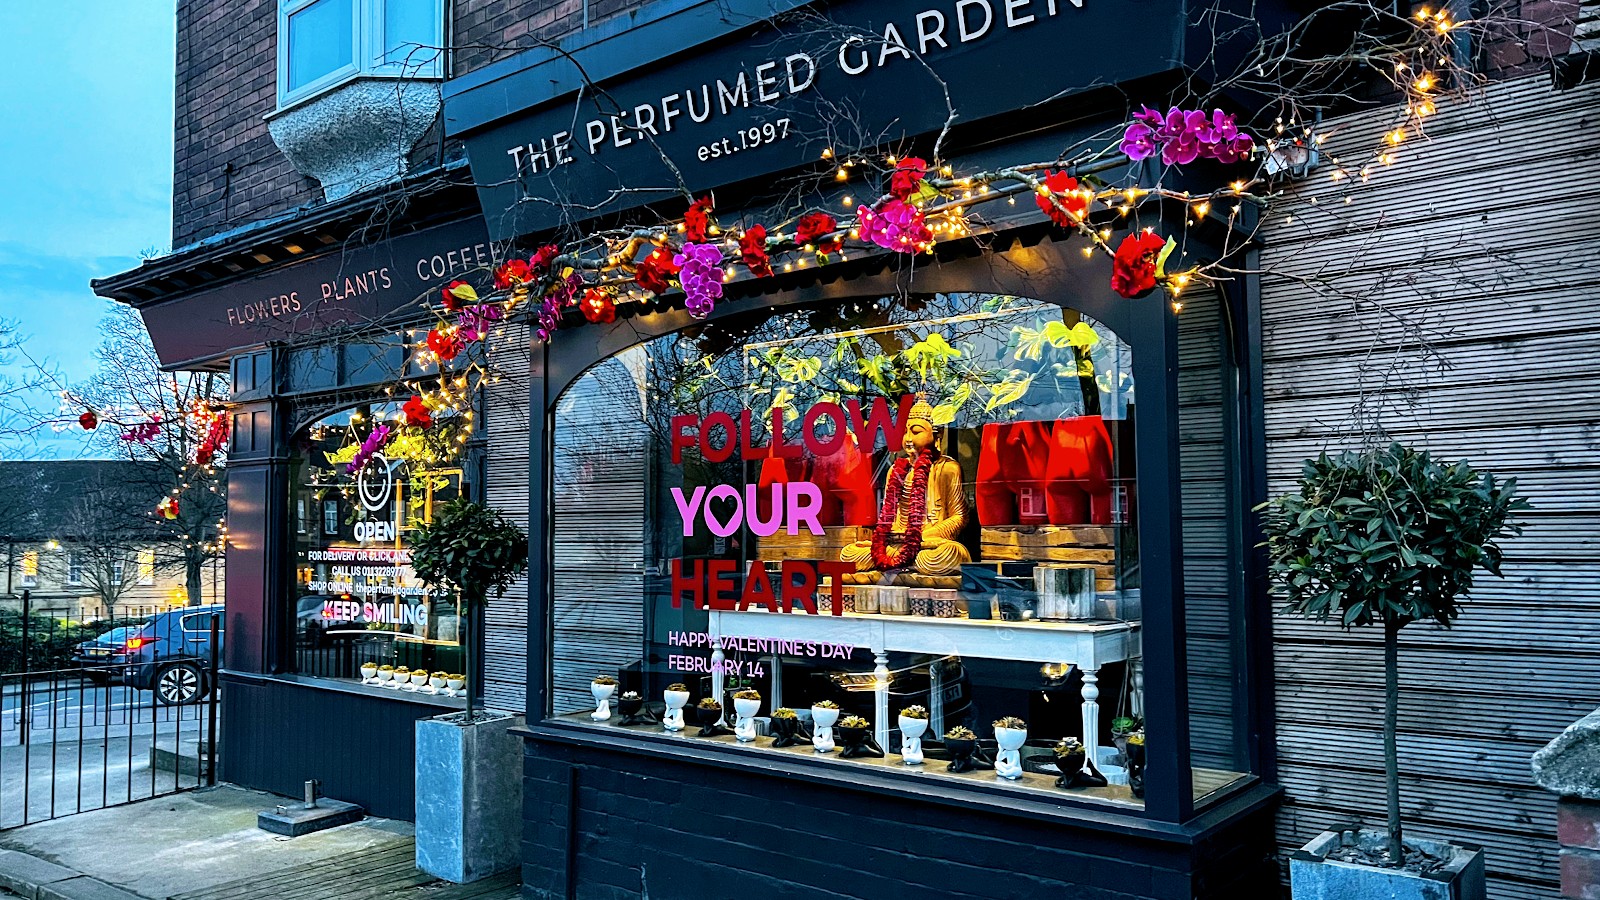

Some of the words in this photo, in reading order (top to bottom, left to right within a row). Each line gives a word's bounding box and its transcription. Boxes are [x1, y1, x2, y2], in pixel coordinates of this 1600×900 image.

[507, 131, 573, 178] THE
[586, 52, 816, 155] PERFUMED
[838, 0, 1085, 75] GARDE
[696, 118, 792, 162] est.1997
[226, 292, 301, 327] FLOWERS
[321, 267, 392, 303] PLANTS
[416, 242, 502, 281] COFFEE
[670, 394, 914, 464] FOLLOW
[670, 481, 826, 537] YOUR
[353, 520, 396, 543] OPEN
[308, 551, 322, 561] FOR
[323, 551, 355, 561] DELIVERY
[356, 551, 368, 561] OR
[369, 551, 391, 562] CLICK
[332, 566, 350, 576] CALL
[351, 566, 361, 576] US
[308, 581, 327, 591] SHOP
[327, 582, 353, 593] ONLINE
[670, 559, 856, 617] HEART
[322, 601, 360, 621] KEEP
[363, 604, 428, 625] SMILING
[668, 630, 715, 649] HAPPY
[719, 637, 817, 657] VALENTINE'S
[821, 641, 855, 660] DAY
[668, 654, 743, 676] FEBRUARY
[746, 661, 764, 679] 14
